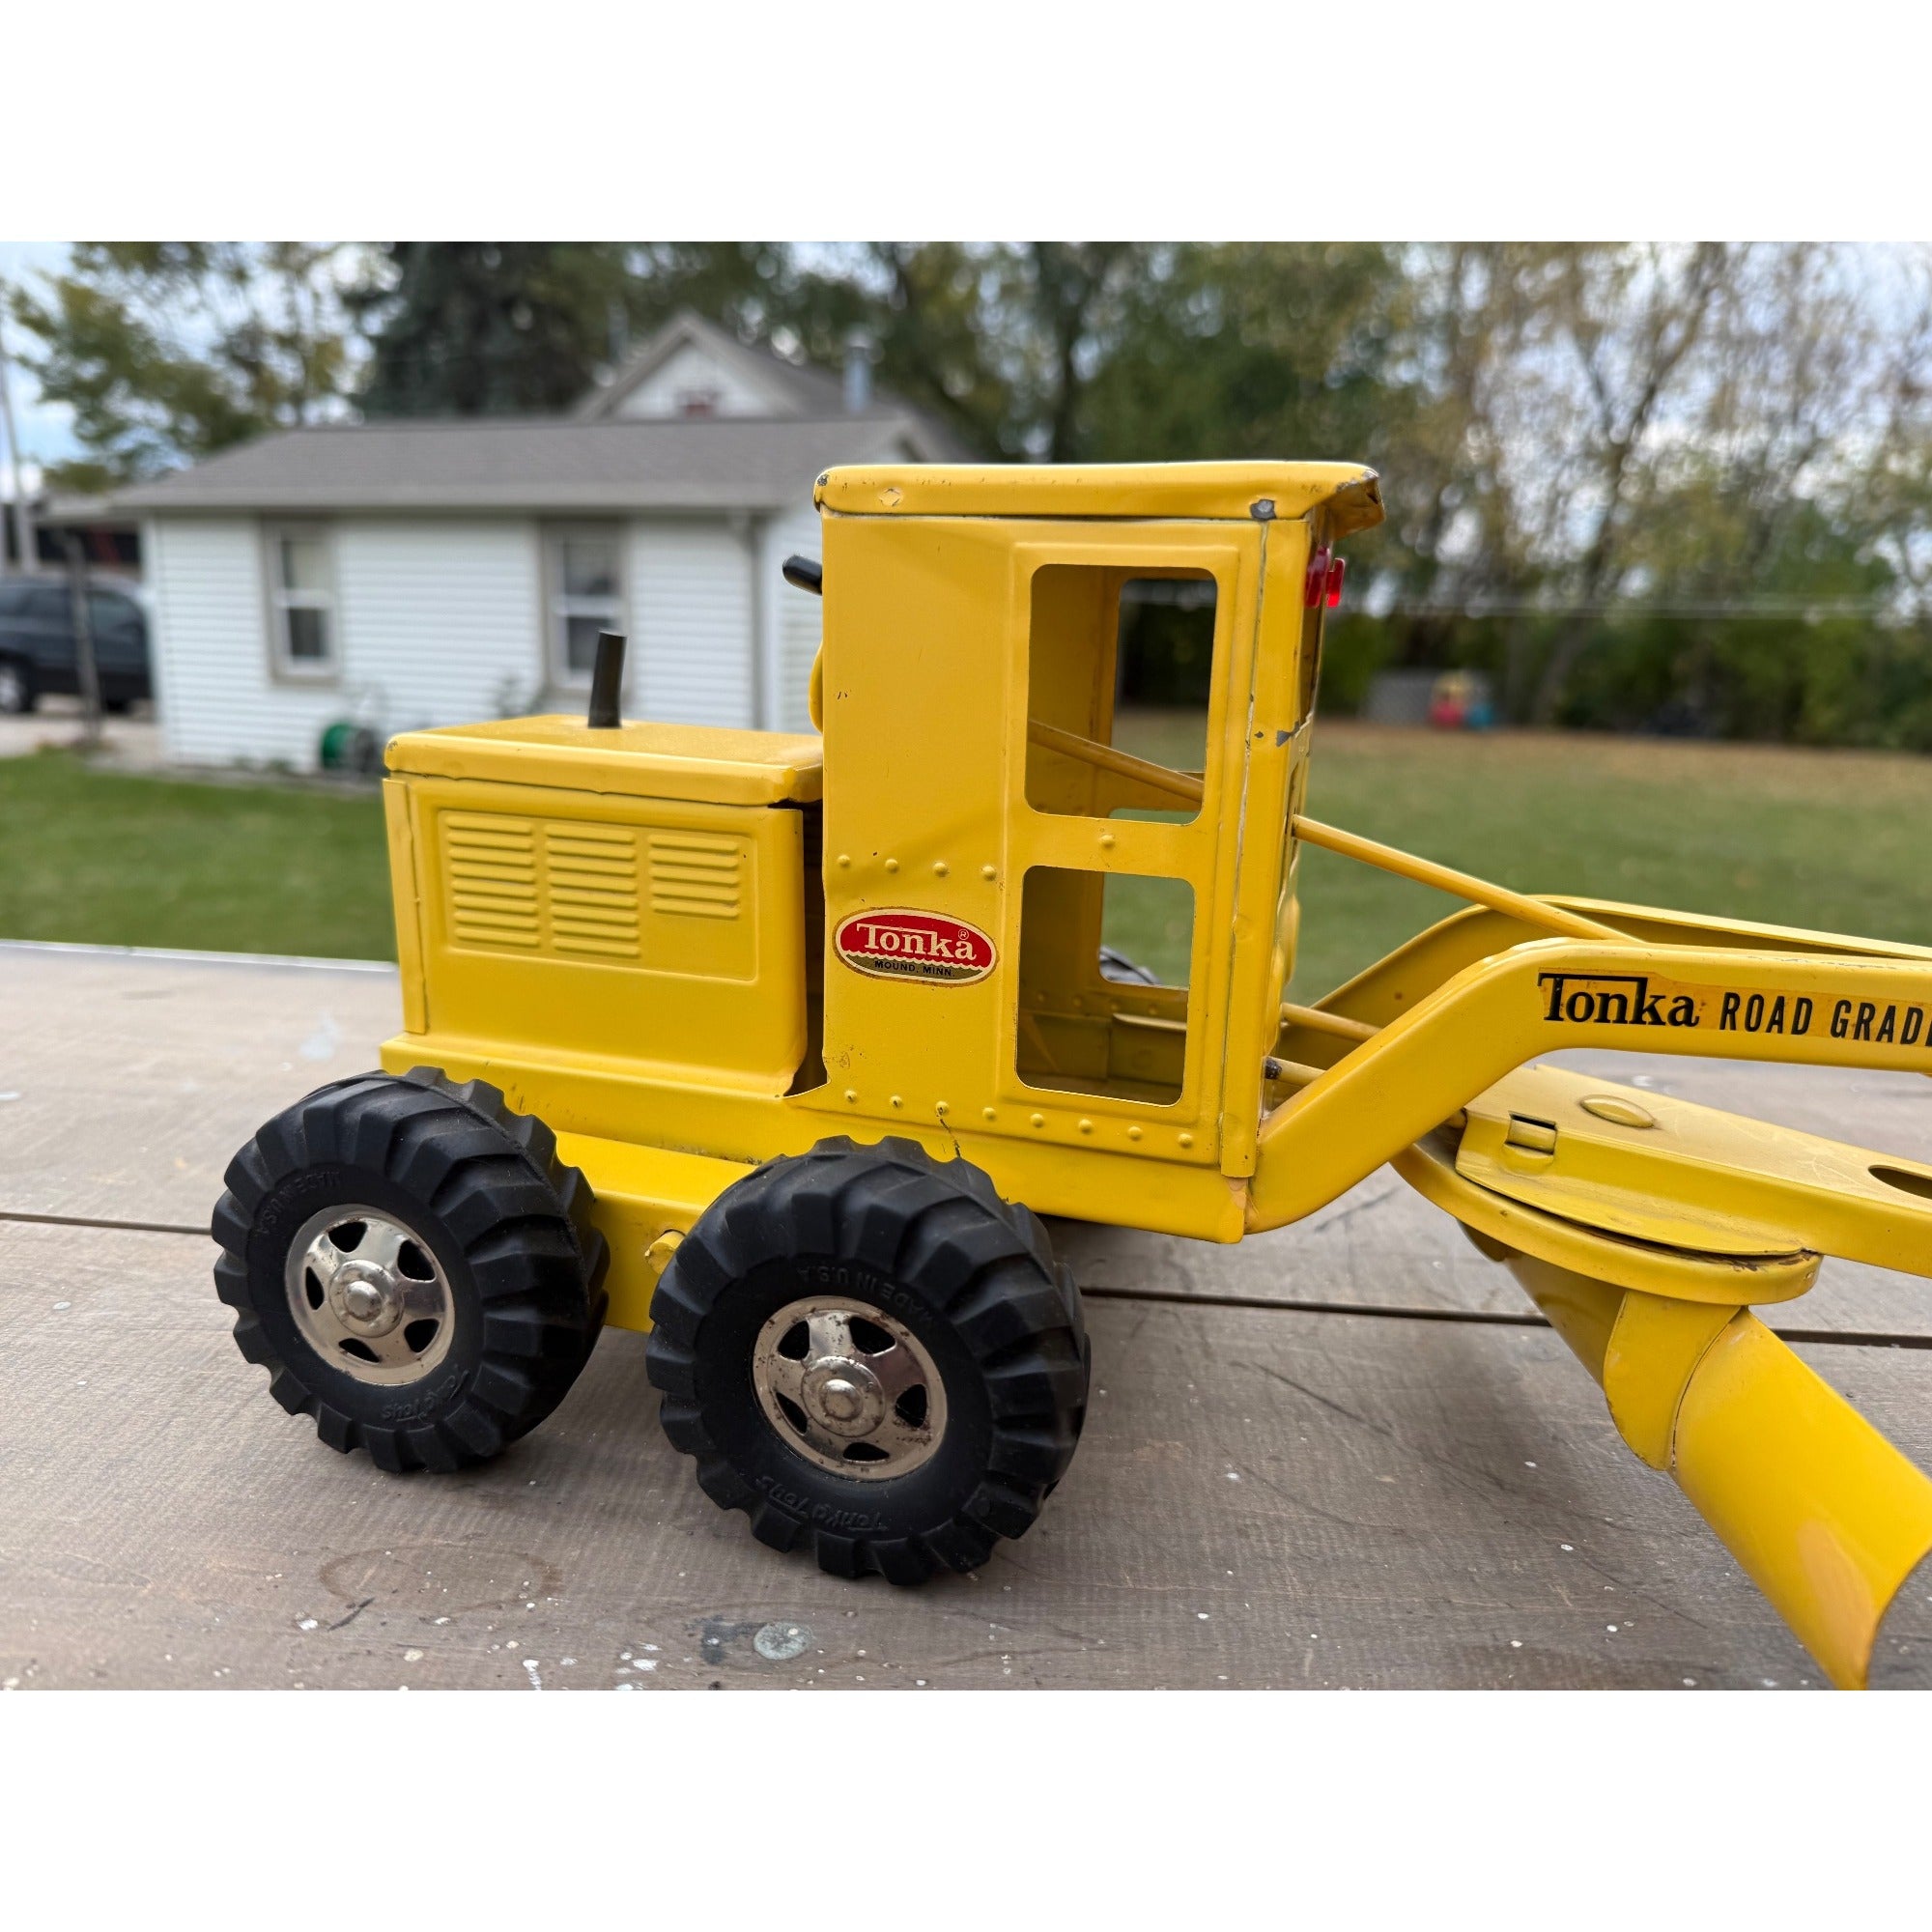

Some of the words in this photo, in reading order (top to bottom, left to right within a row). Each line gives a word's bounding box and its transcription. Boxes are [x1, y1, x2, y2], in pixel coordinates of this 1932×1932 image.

[856, 923, 977, 960] Tonka
[1537, 972, 1700, 1027] Tonka
[1719, 991, 1813, 1036] ROAD
